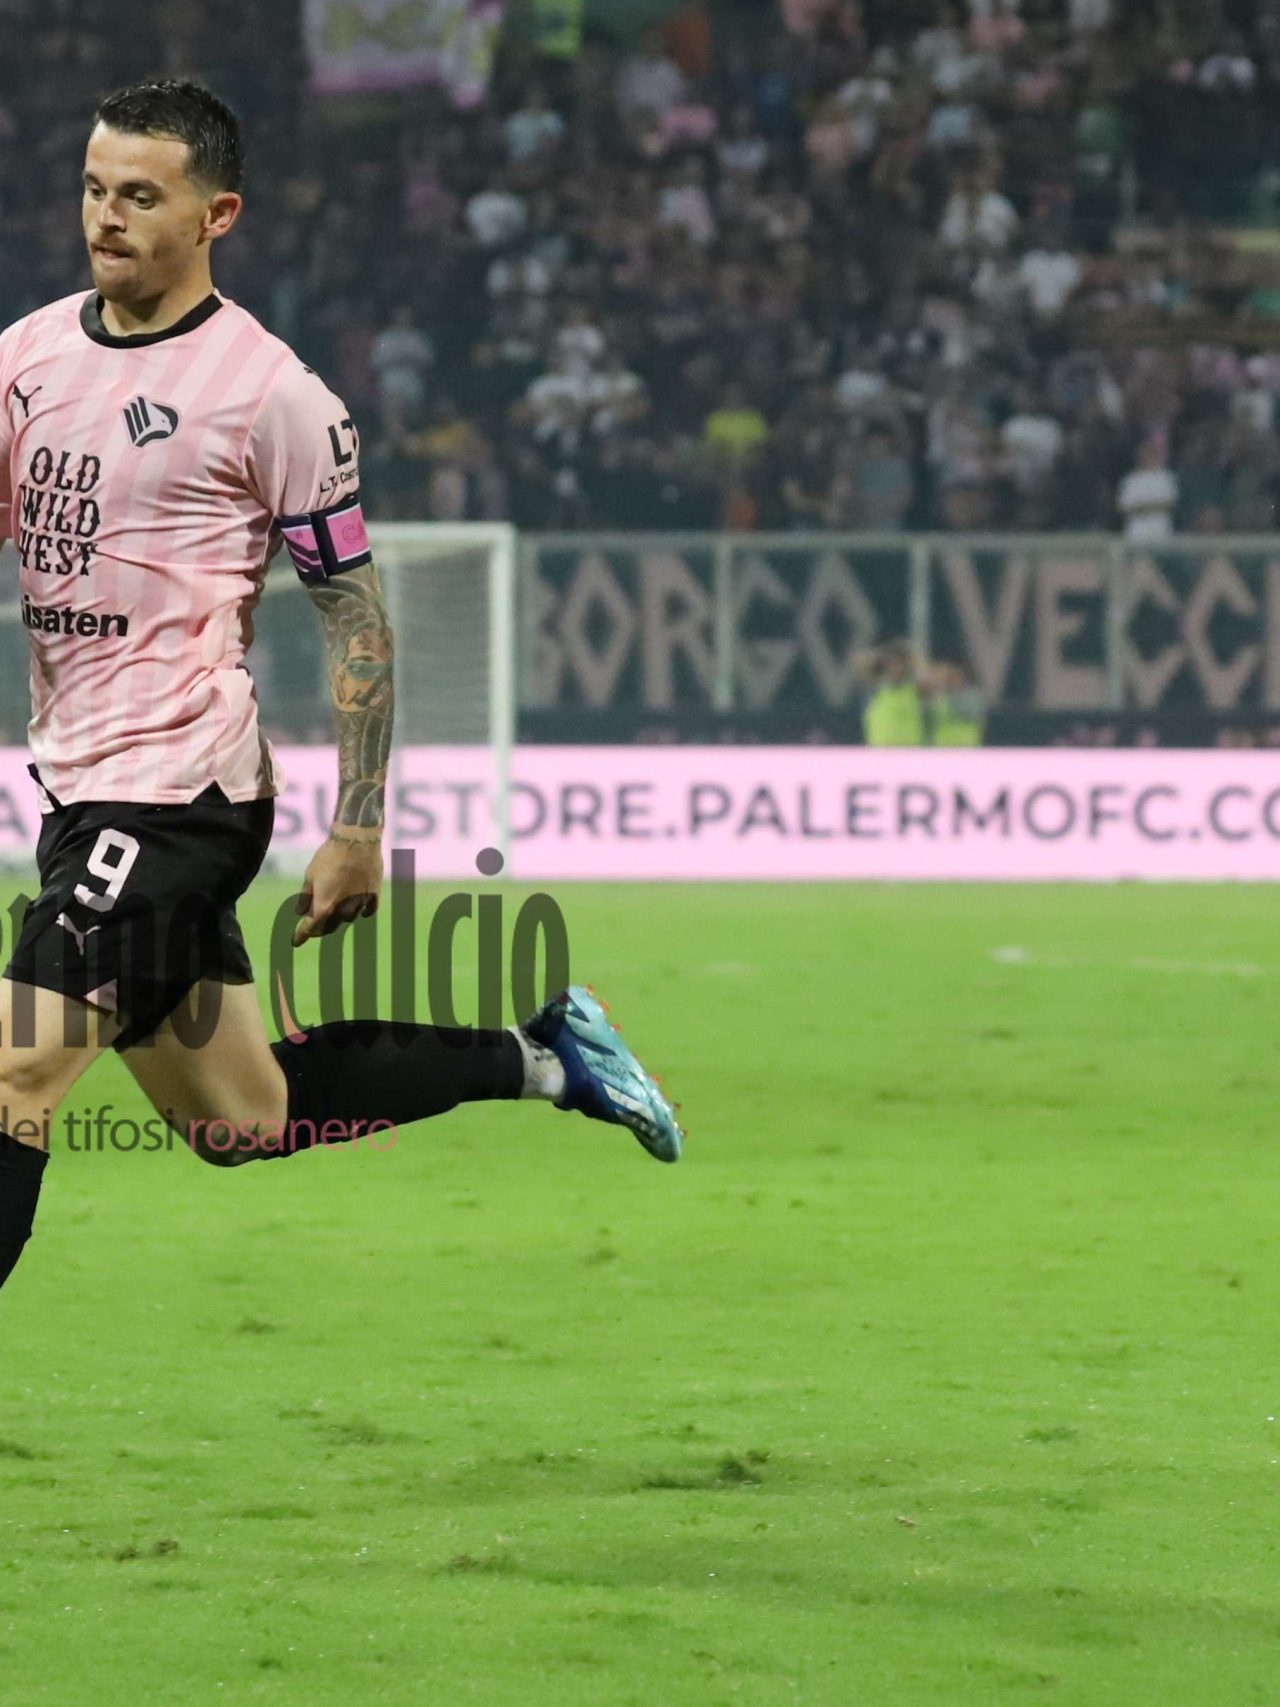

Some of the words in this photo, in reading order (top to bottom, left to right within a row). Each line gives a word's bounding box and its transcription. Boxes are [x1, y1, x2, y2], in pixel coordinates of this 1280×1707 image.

[30, 446, 100, 493] OLD
[19, 485, 100, 538] WILD
[21, 594, 129, 637] isaten
[938, 548, 1280, 709] VECC
[73, 828, 141, 913] 9
